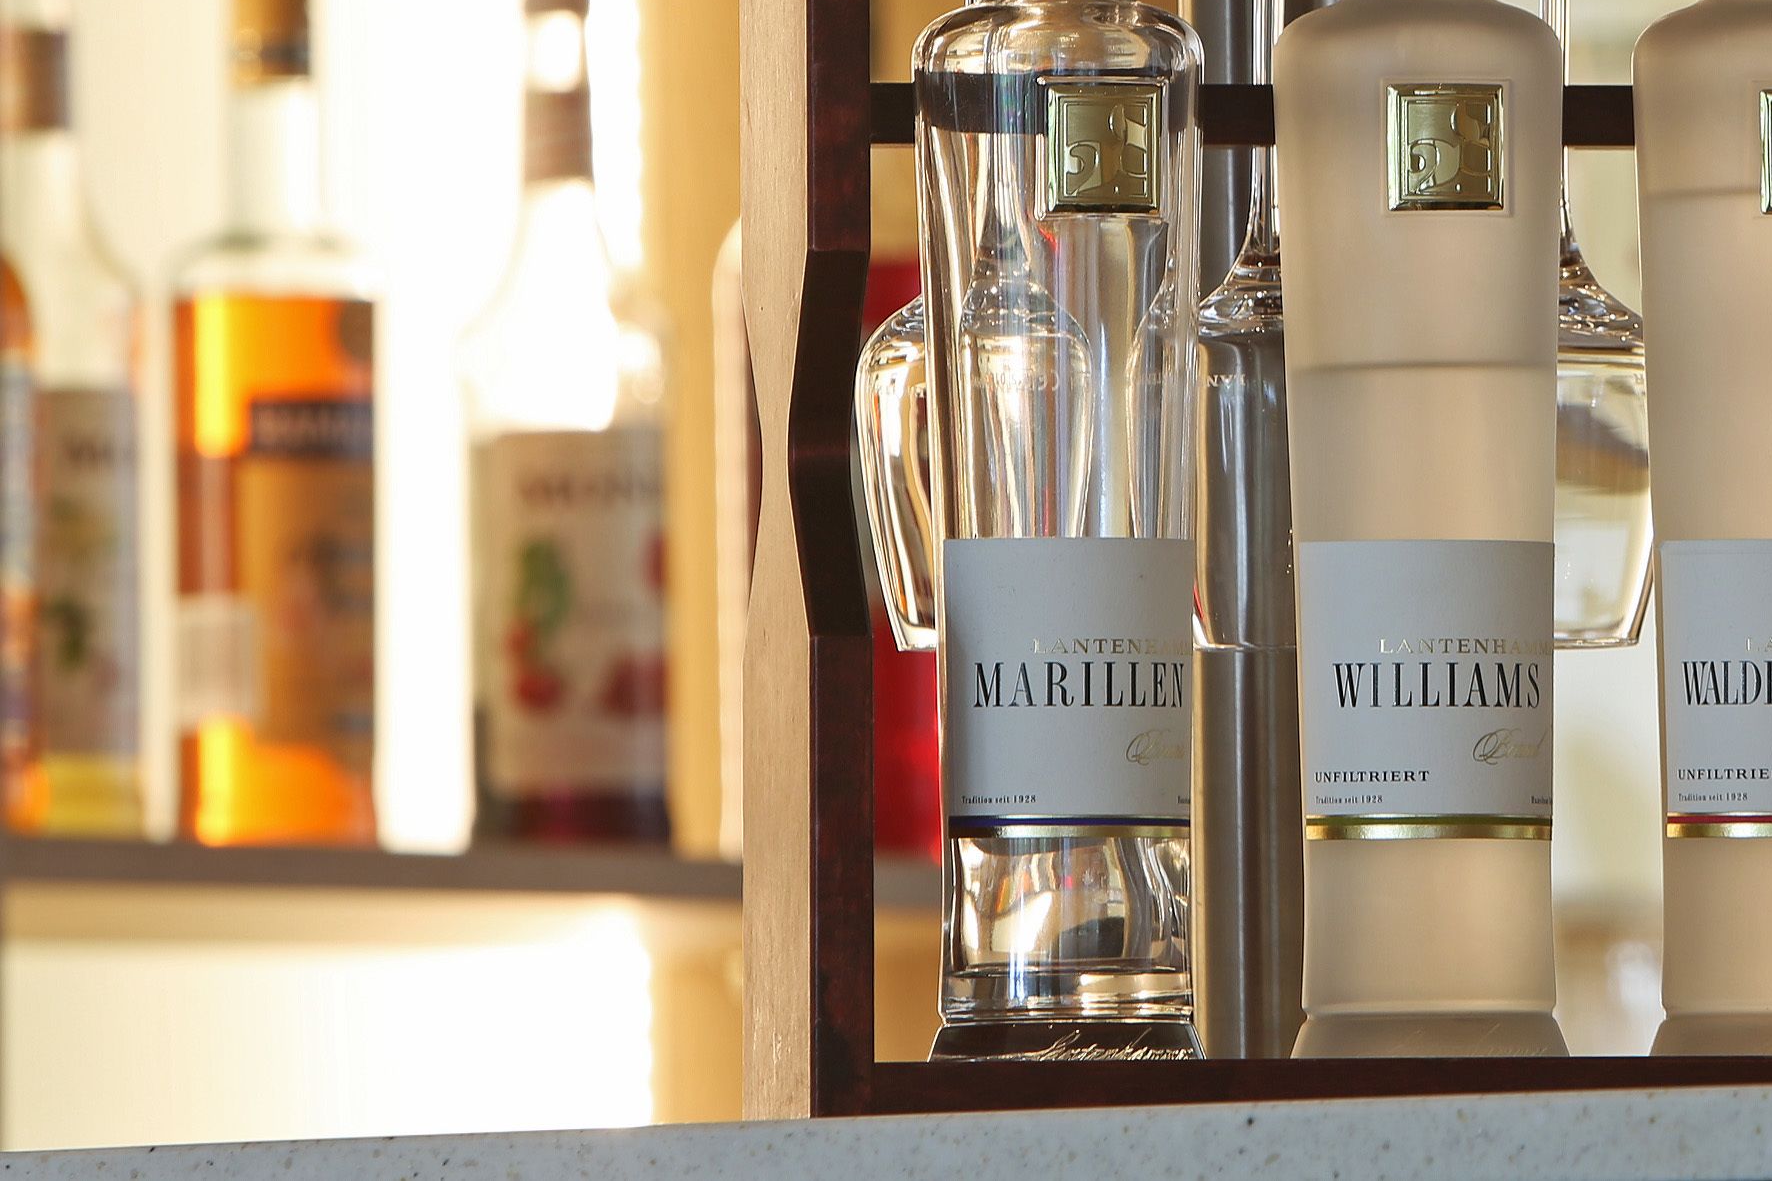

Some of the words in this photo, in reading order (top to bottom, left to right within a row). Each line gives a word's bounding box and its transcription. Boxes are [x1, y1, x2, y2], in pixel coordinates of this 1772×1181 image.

[1031, 638, 1192, 656] LANTENH
[1379, 638, 1552, 656] LANTENHA
[973, 661, 1184, 708] MARILLEN
[1332, 662, 1540, 709] WILLIAMS
[1472, 728, 1548, 765] Brd
[1315, 770, 1430, 783] UNFILTRIERT
[961, 795, 993, 804] Tradition
[995, 795, 1009, 804] seit
[1013, 794, 1037, 804] 1928
[1344, 795, 1358, 804] seit
[1361, 794, 1383, 804] 1928
[1708, 793, 1723, 802] seit
[1726, 792, 1748, 802] 1928
